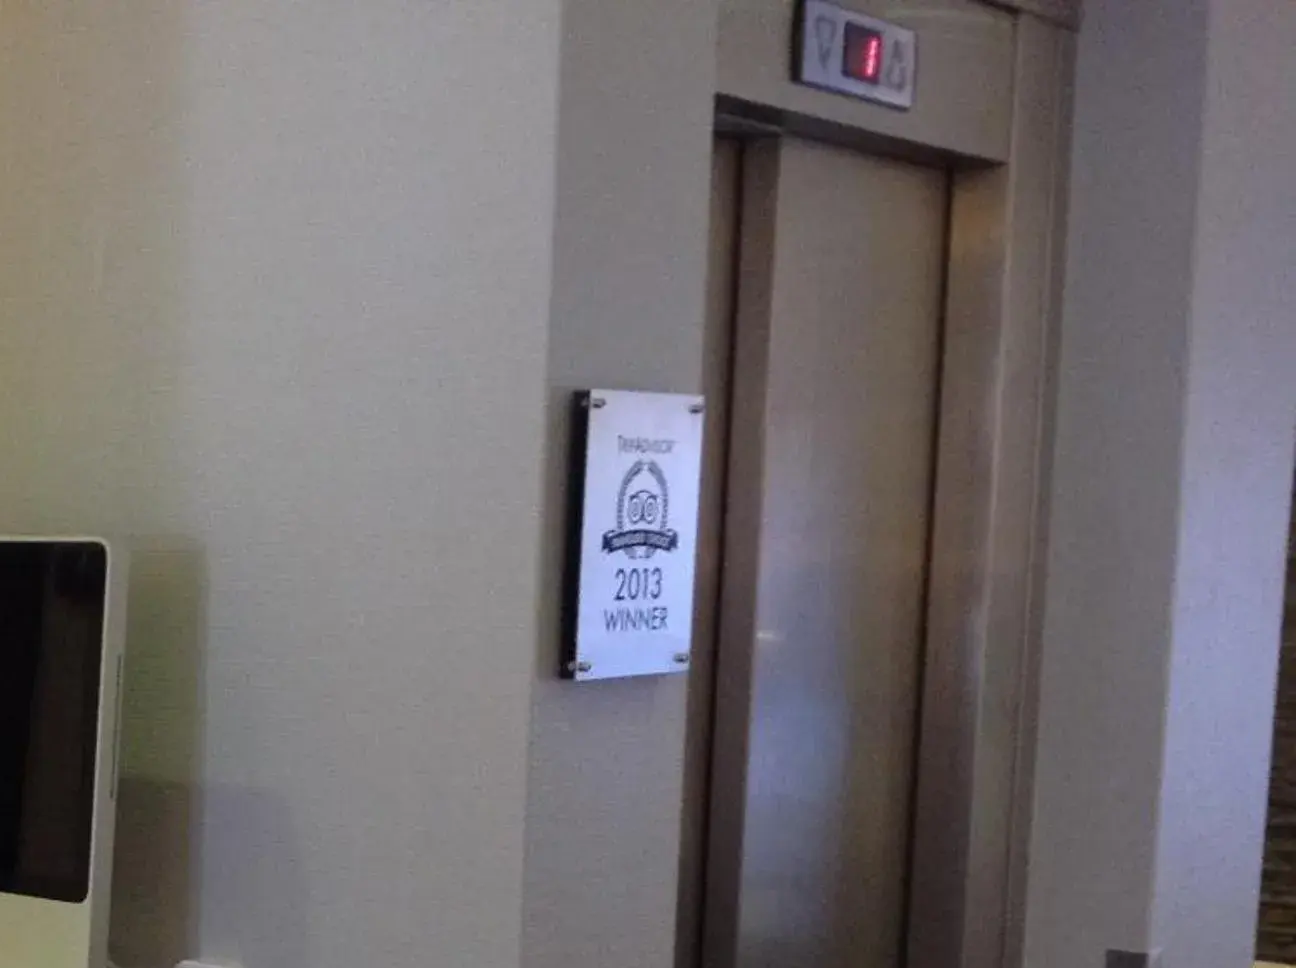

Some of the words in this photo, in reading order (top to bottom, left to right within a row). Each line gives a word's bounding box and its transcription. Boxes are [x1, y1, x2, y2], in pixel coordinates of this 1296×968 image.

[863, 35, 881, 78] 1
[614, 567, 663, 602] 2013
[604, 606, 669, 632] WINNER
